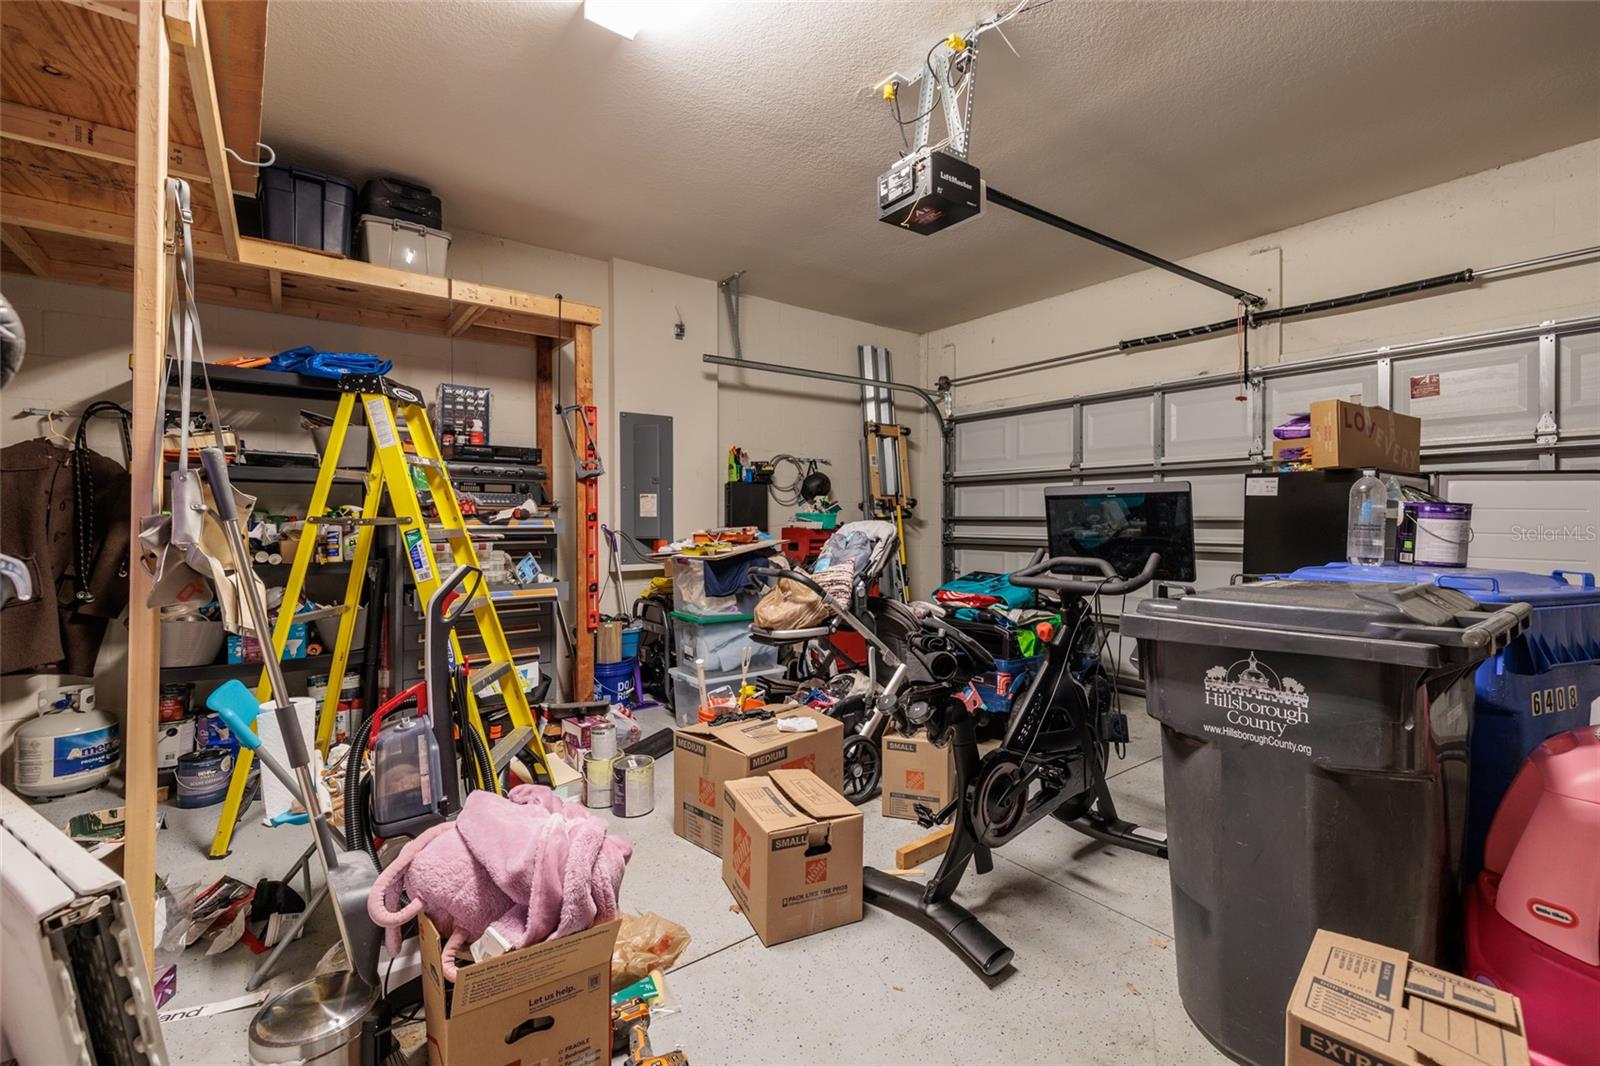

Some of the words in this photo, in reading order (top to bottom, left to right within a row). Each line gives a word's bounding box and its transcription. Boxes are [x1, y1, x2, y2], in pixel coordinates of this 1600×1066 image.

[940, 171, 973, 190] LiftMaster
[1343, 407, 1418, 470] LOVEVERY
[1205, 692, 1309, 725] Hillsborough
[1532, 687, 1577, 715] 6408
[1227, 710, 1287, 737] County
[677, 738, 705, 756] MEDIUM
[889, 742, 915, 751] SMALL
[1203, 724, 1312, 757] www.HillsboroughCounty.org
[752, 749, 786, 767] MEDIUM
[775, 835, 807, 849] SMALL
[529, 996, 543, 1007] Let
[545, 992, 555, 1000] us
[556, 985, 576, 997] help.
[1309, 1033, 1386, 1066] EXTR
